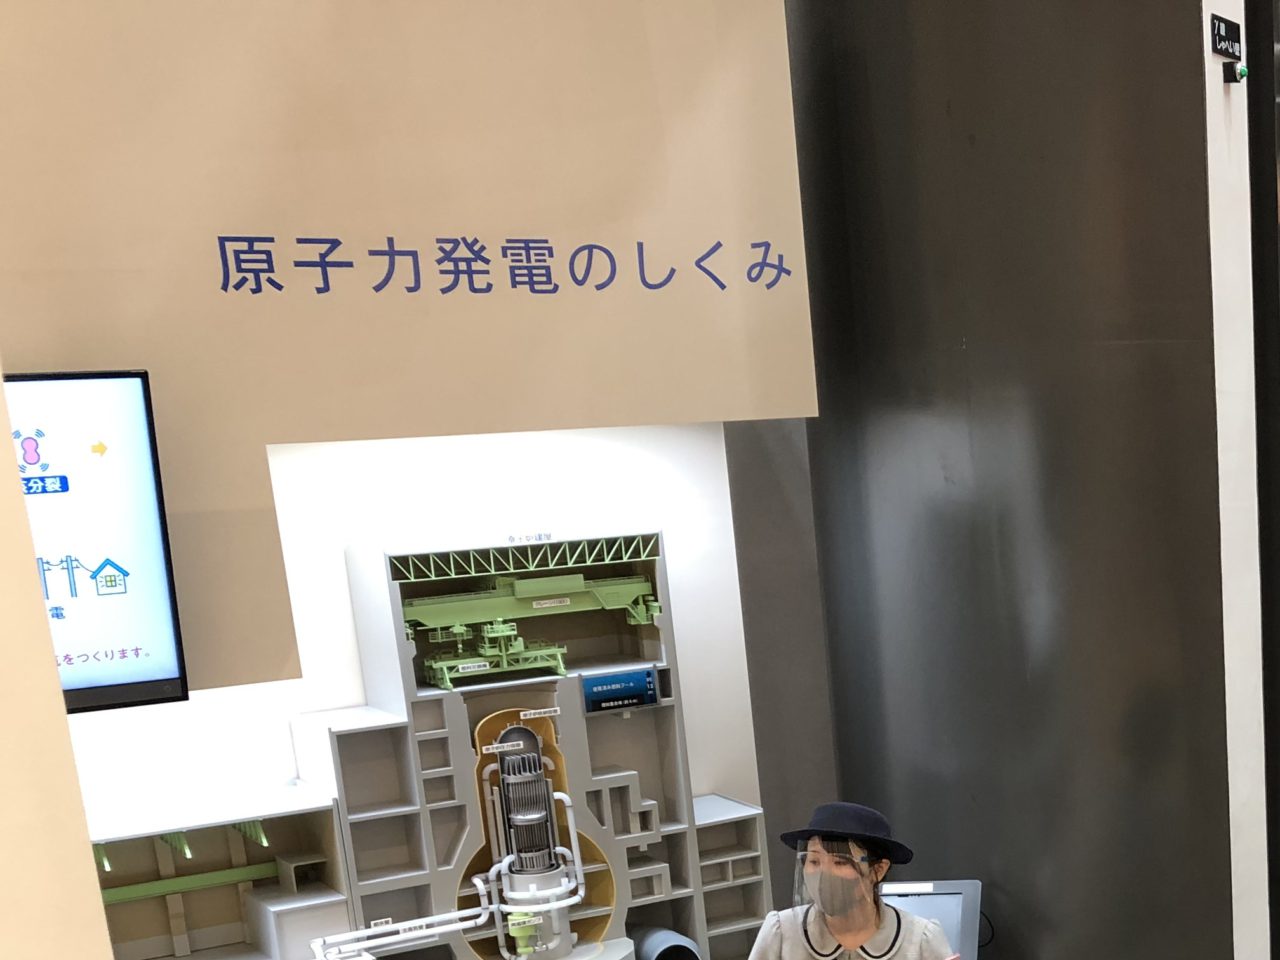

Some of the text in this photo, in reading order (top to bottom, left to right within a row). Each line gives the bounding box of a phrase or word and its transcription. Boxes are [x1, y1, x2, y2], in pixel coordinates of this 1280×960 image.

[217, 235, 792, 295] 原子力発電のしくみ
